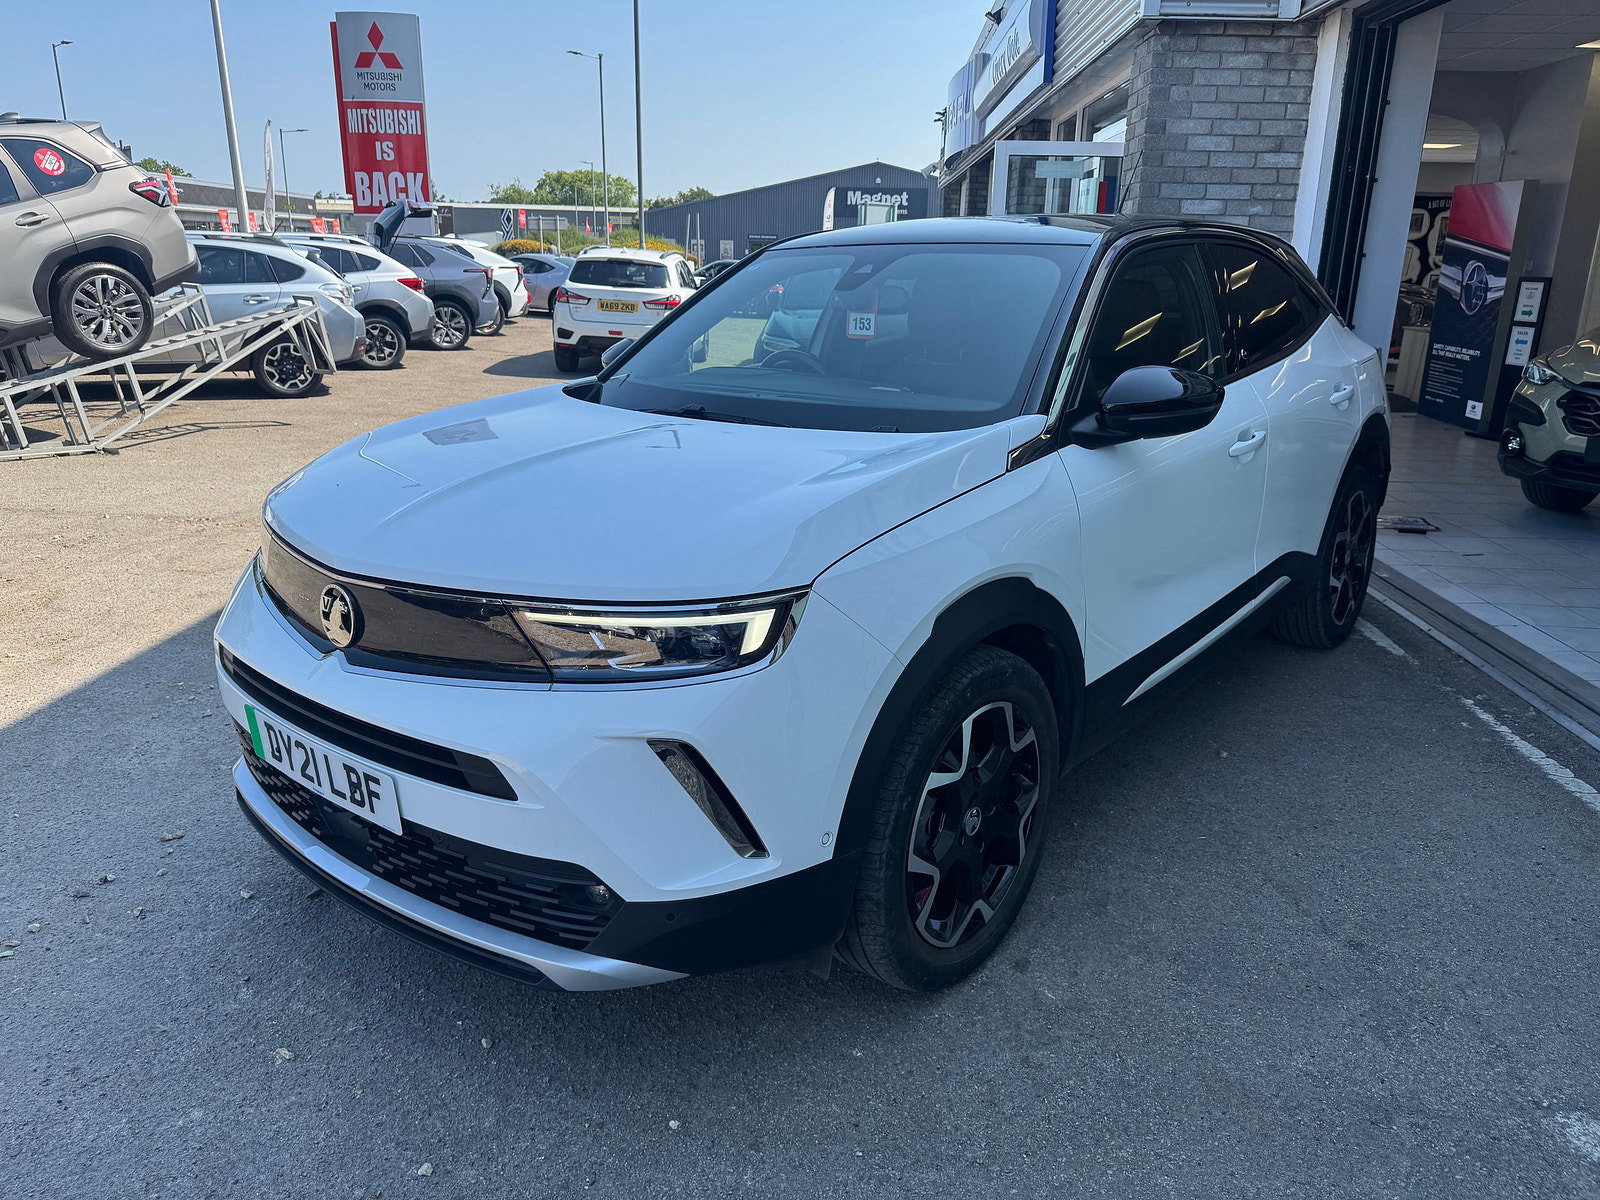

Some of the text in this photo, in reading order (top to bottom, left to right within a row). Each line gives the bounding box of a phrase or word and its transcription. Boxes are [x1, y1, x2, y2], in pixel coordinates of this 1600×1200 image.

[357, 72, 402, 82] MITSUBISHI
[363, 82, 396, 92] MOTORS
[347, 108, 422, 135] MITSUBISHI
[375, 141, 395, 161] IS
[354, 171, 425, 207] BACK
[847, 190, 909, 206] Magnet
[600, 302, 635, 311] WA69 ZKB
[852, 317, 871, 331] 153
[263, 720, 382, 815] DY21 LBF
